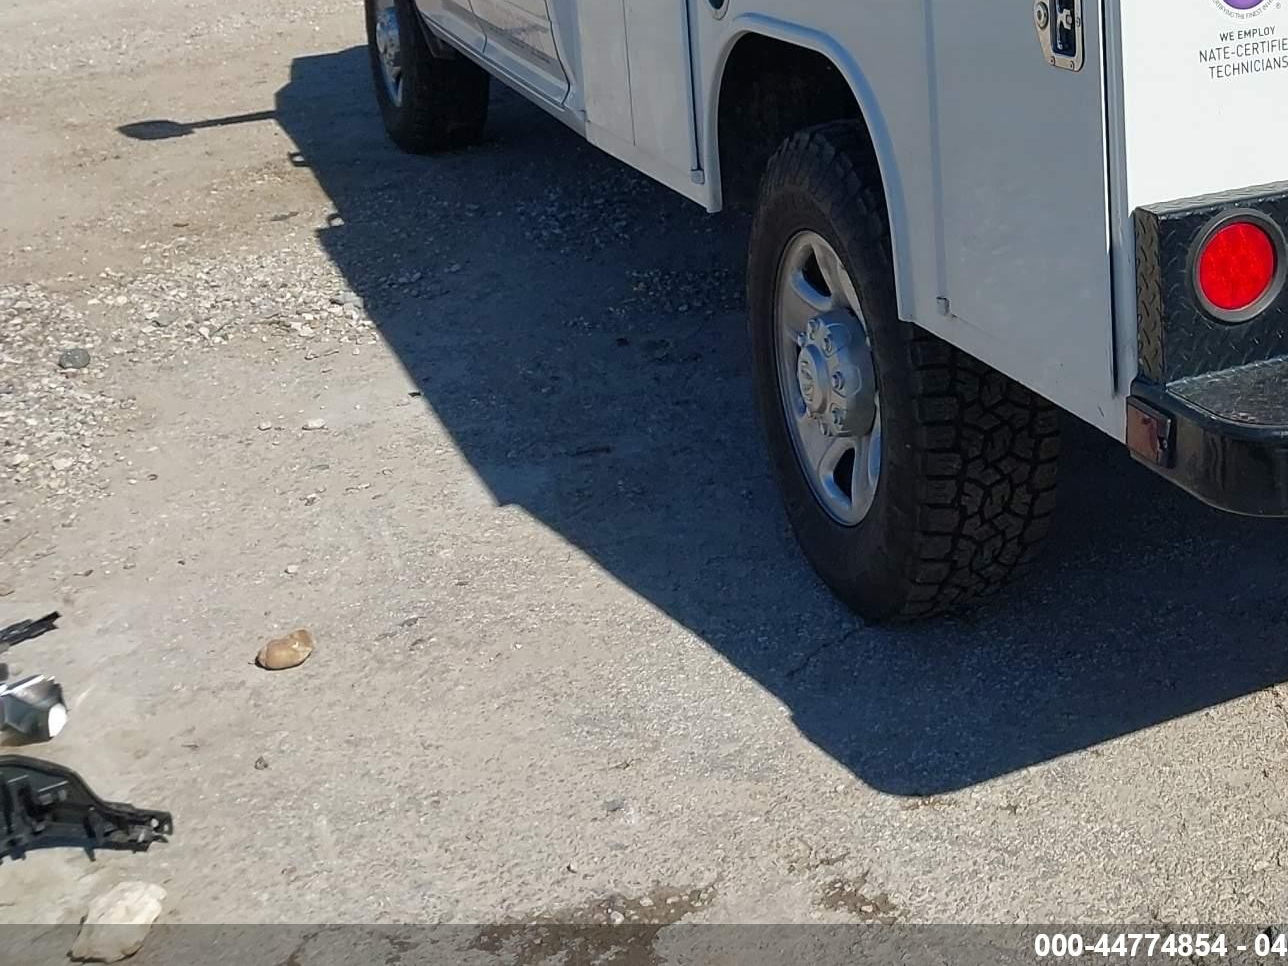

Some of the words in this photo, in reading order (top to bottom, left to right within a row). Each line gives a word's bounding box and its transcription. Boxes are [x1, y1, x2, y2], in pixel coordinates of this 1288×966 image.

[1220, 30, 1234, 43] WE
[1237, 26, 1276, 41] EMPLOY
[1209, 56, 1288, 79] TECHNICIANS
